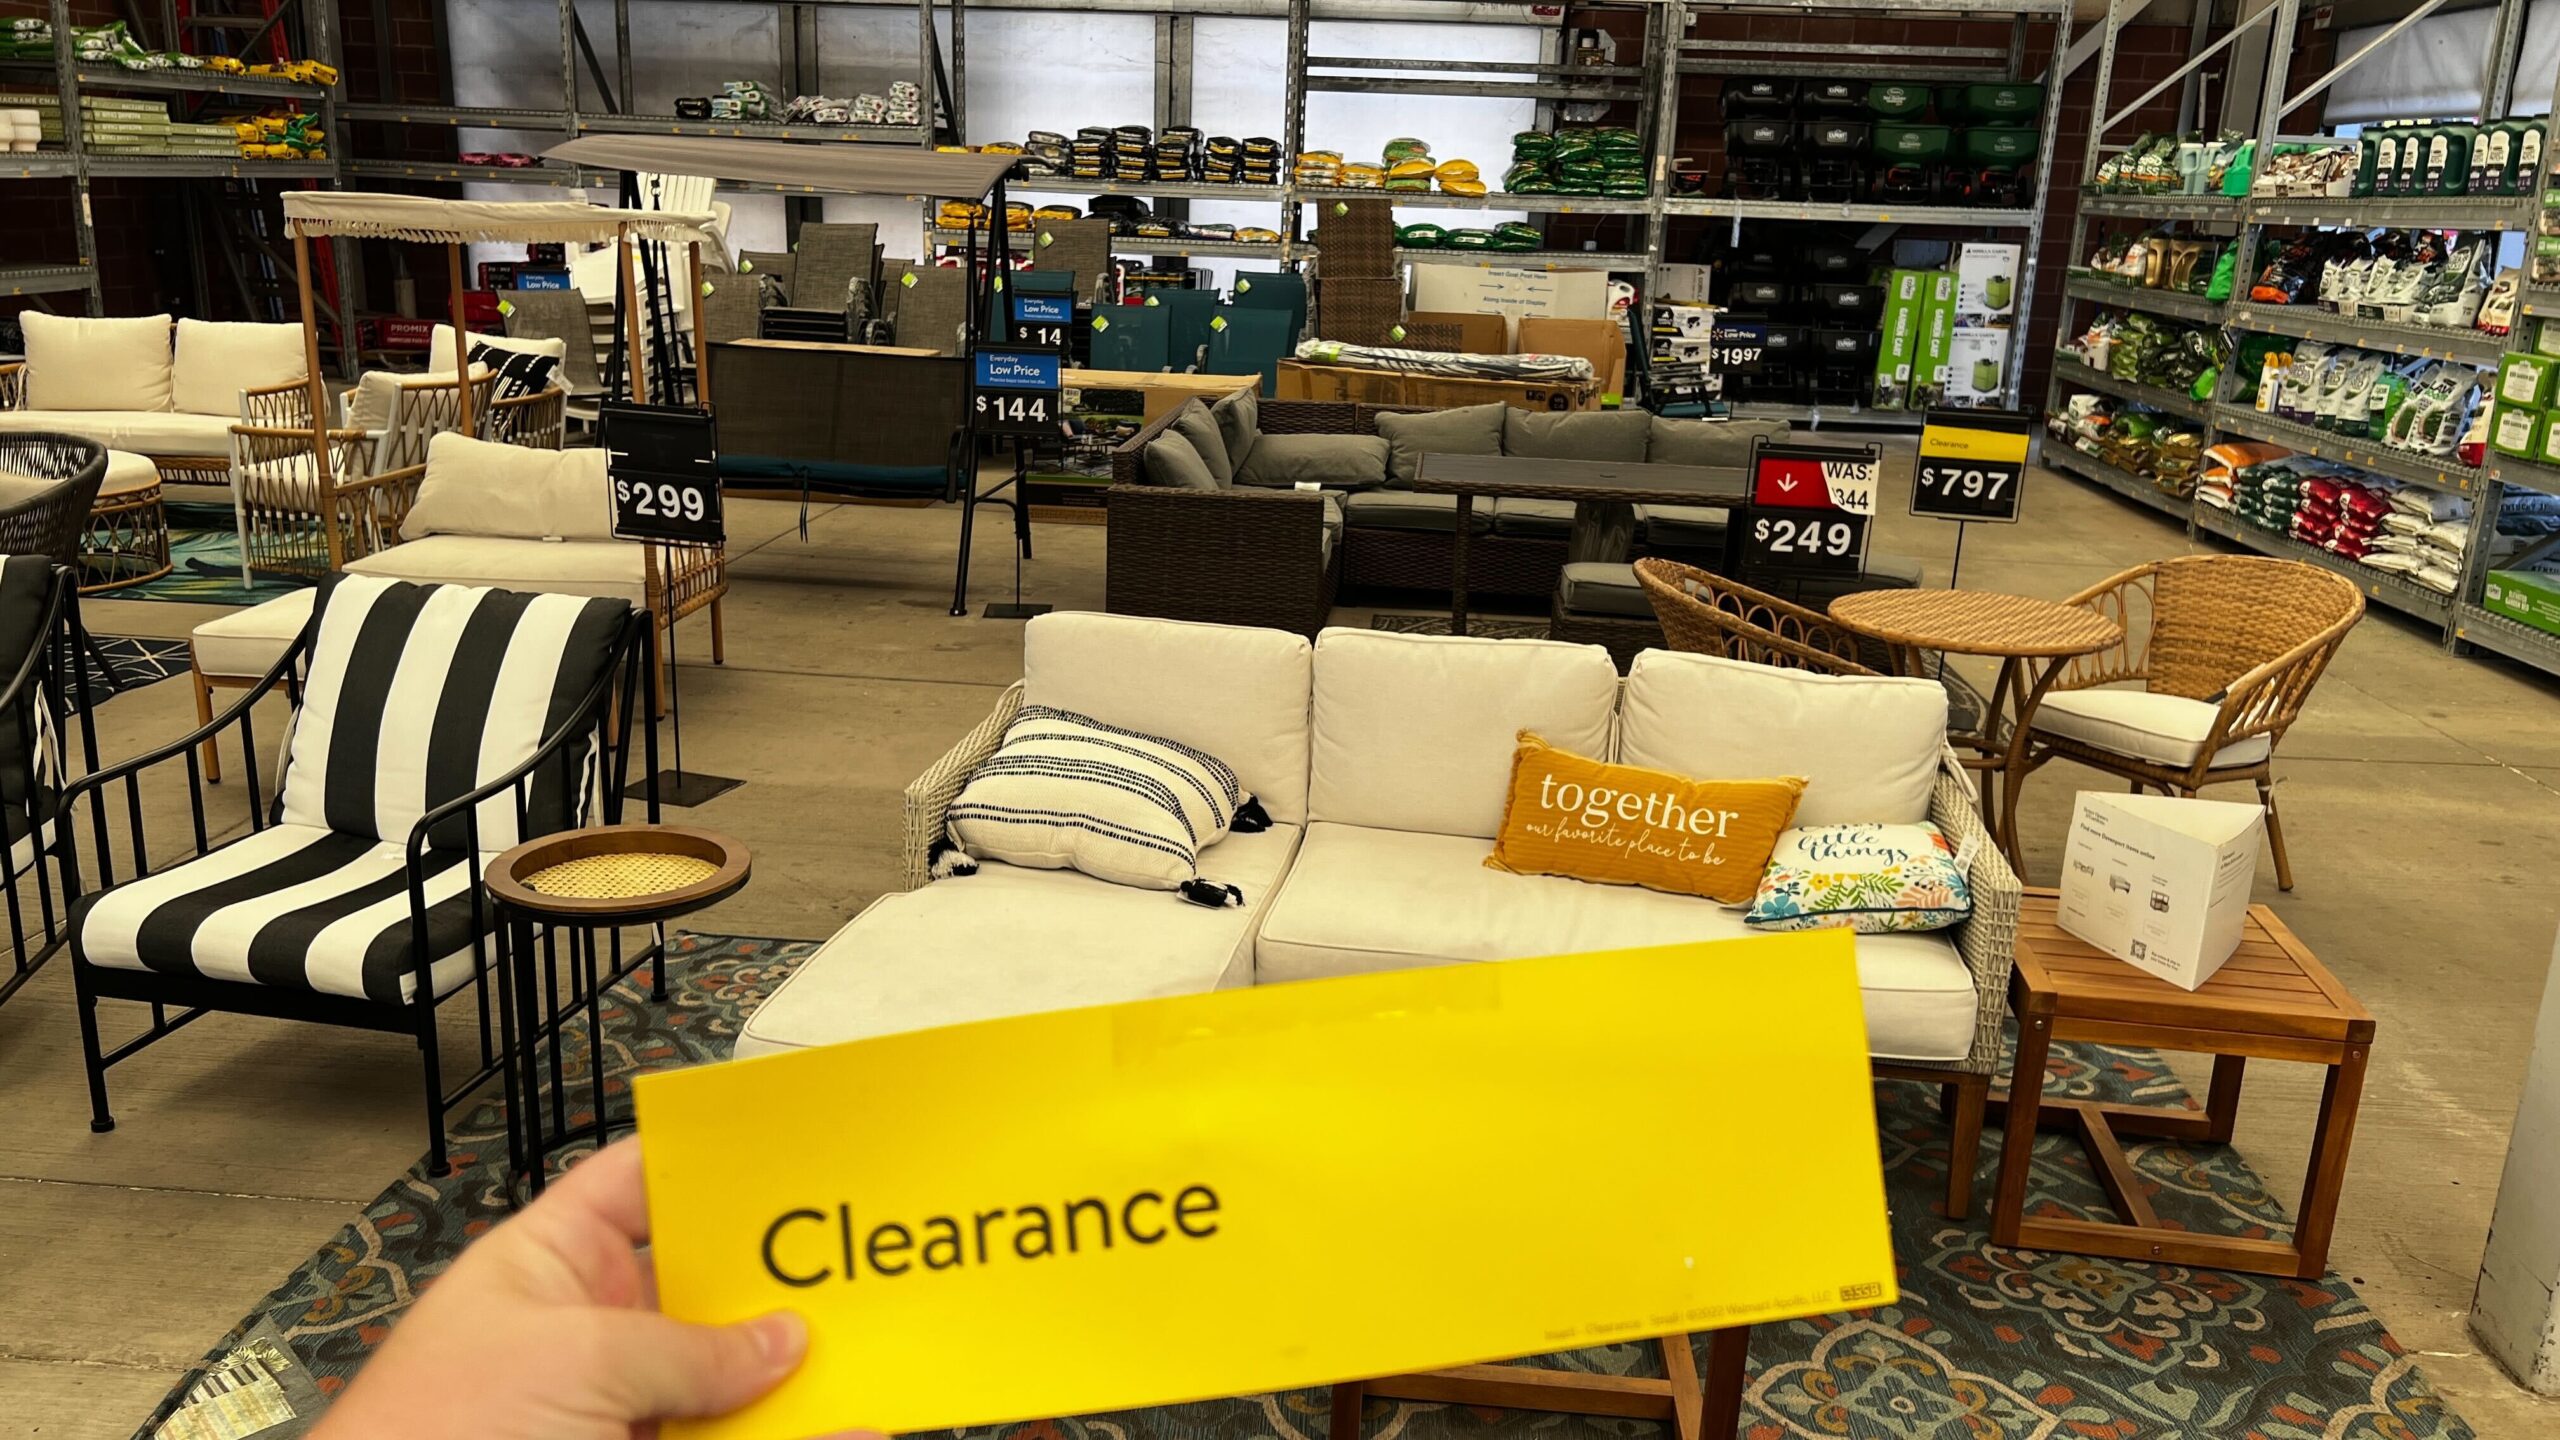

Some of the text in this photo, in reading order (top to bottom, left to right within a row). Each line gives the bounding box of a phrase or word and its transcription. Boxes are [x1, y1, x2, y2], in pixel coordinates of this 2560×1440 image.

[526, 280, 560, 290] Low Price
[1024, 304, 1060, 314] Low Price
[1724, 330, 1757, 339] Low Price
[989, 354, 1019, 364] Everyday
[990, 364, 1041, 377] Low Price
[1930, 438, 1969, 450] Clearance
[1826, 462, 1872, 480] WAS:
[1921, 467, 2009, 501] $797
[617, 480, 705, 522] $299
[1755, 518, 1852, 556] $249
[1540, 773, 1740, 838] together
[1525, 815, 1727, 866] our favorite place to be
[1797, 831, 1880, 851] little
[2080, 822, 2090, 831] Find
[2090, 829, 2101, 837] more
[2140, 851, 2156, 861] online
[1810, 843, 1909, 867] things
[761, 1182, 1222, 1289] Clearance
[1726, 1301, 1770, 1314] Walmart
[1773, 1295, 1809, 1311] Apollo,
